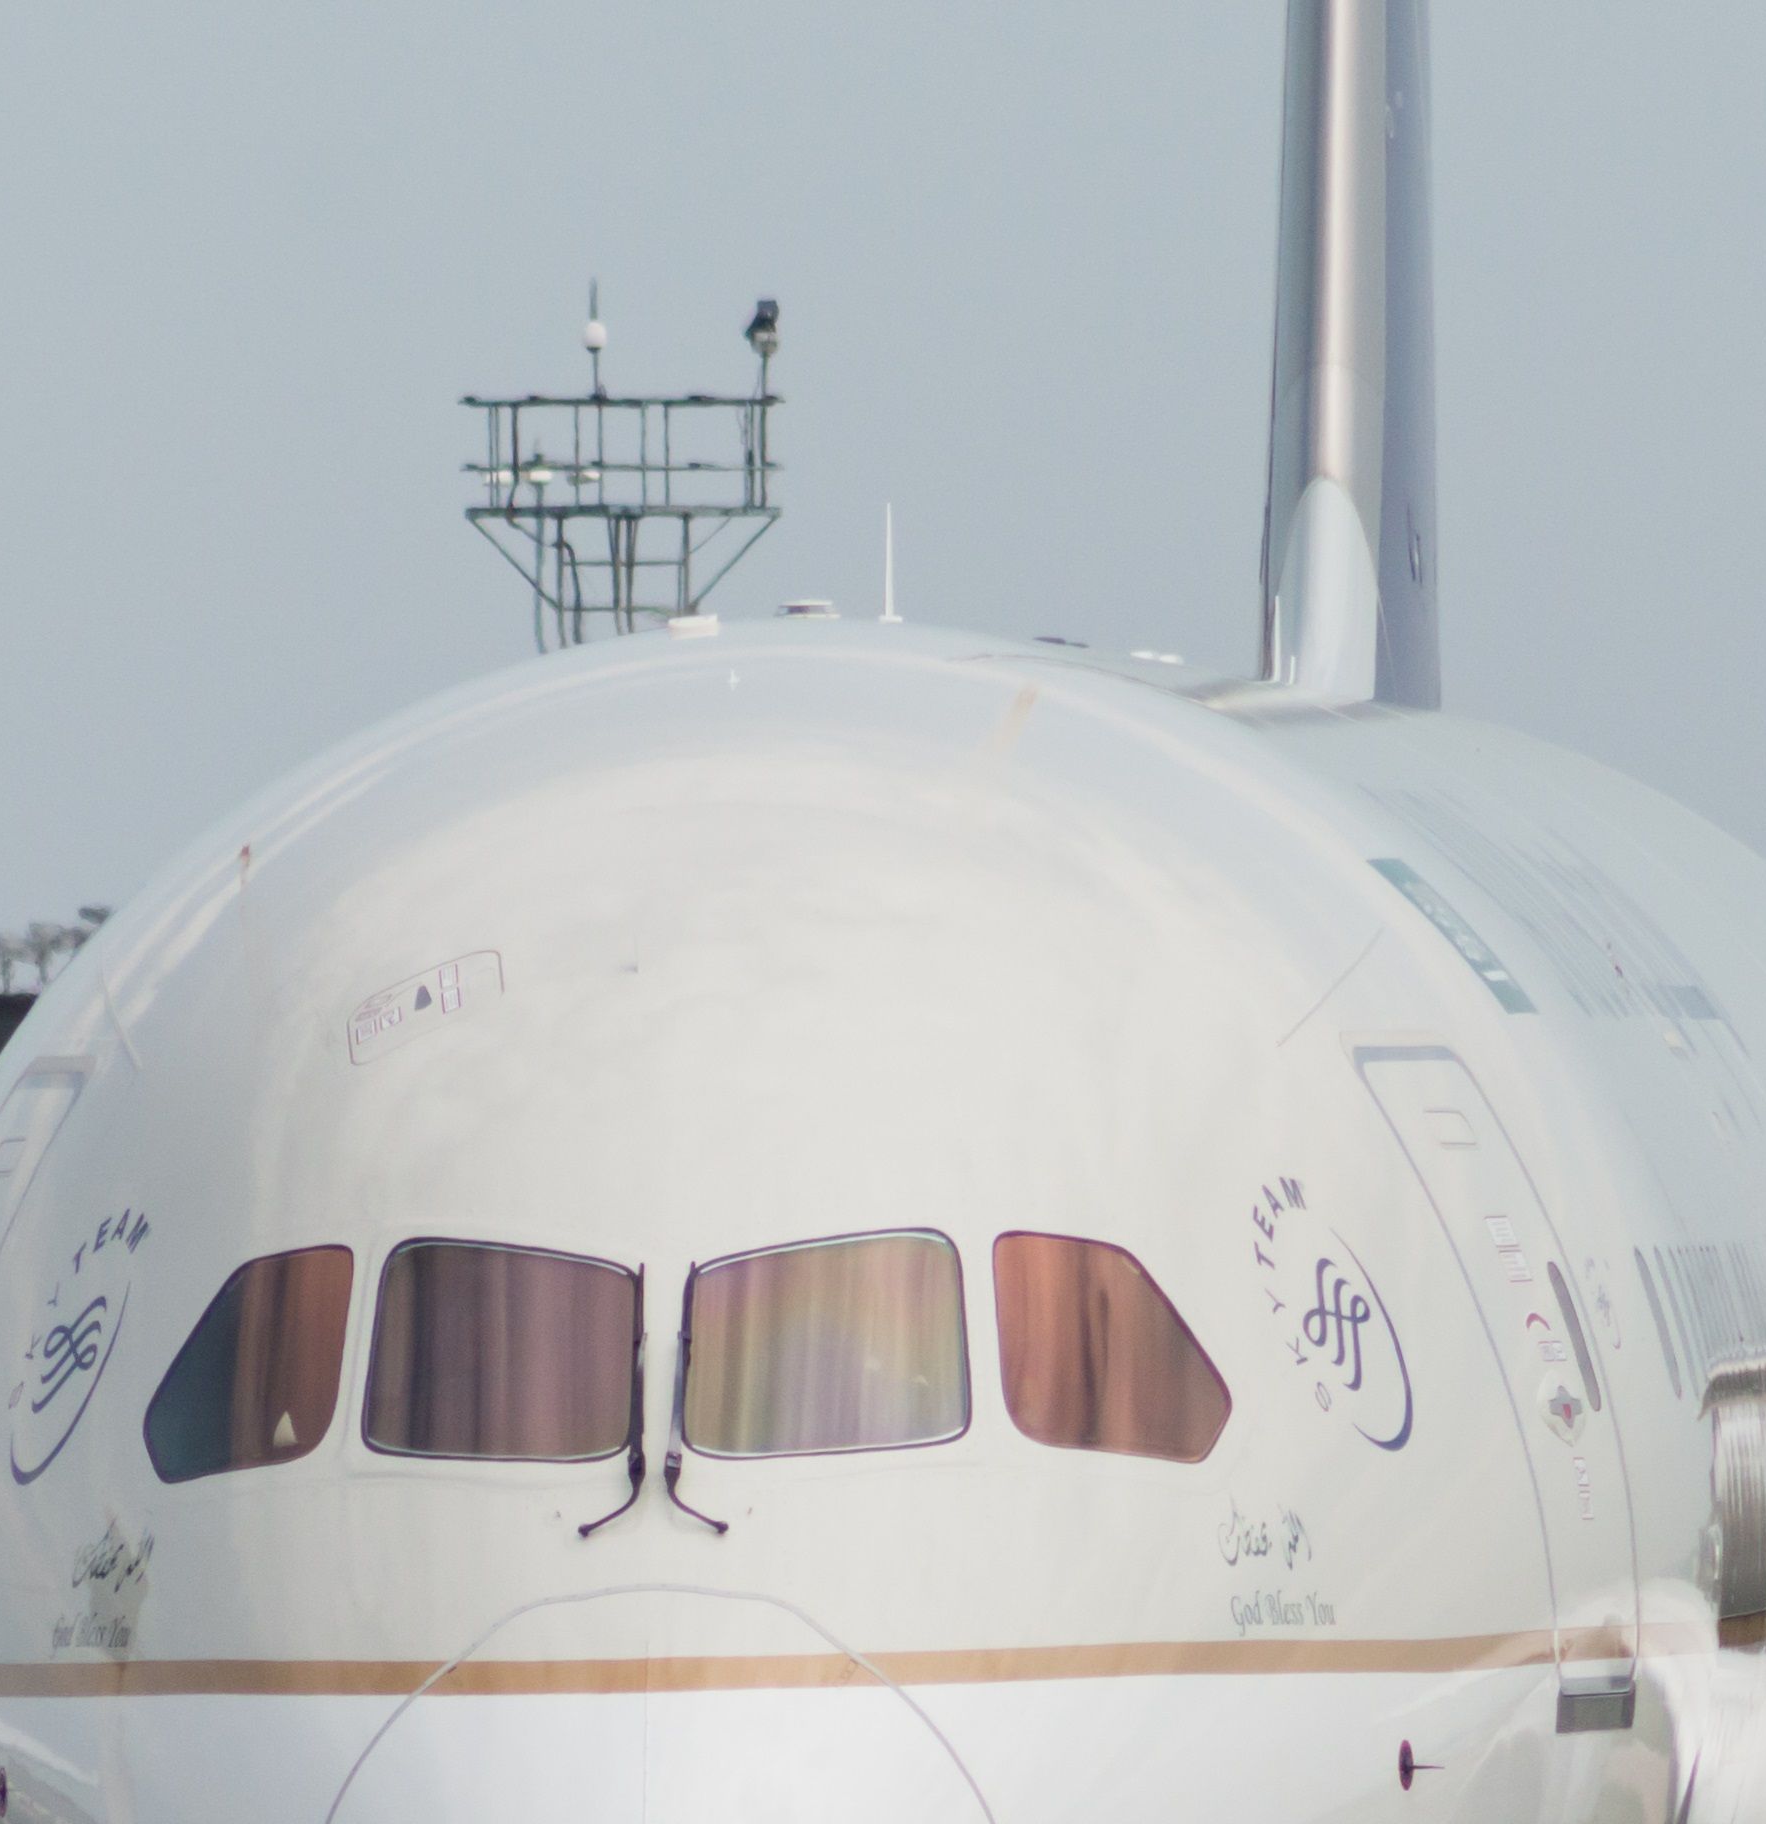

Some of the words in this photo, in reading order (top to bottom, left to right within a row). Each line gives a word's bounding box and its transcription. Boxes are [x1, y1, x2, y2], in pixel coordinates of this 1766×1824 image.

[1230, 1589, 1264, 1637] God
[1266, 1589, 1305, 1626] Bless
[1306, 1591, 1336, 1627] You
